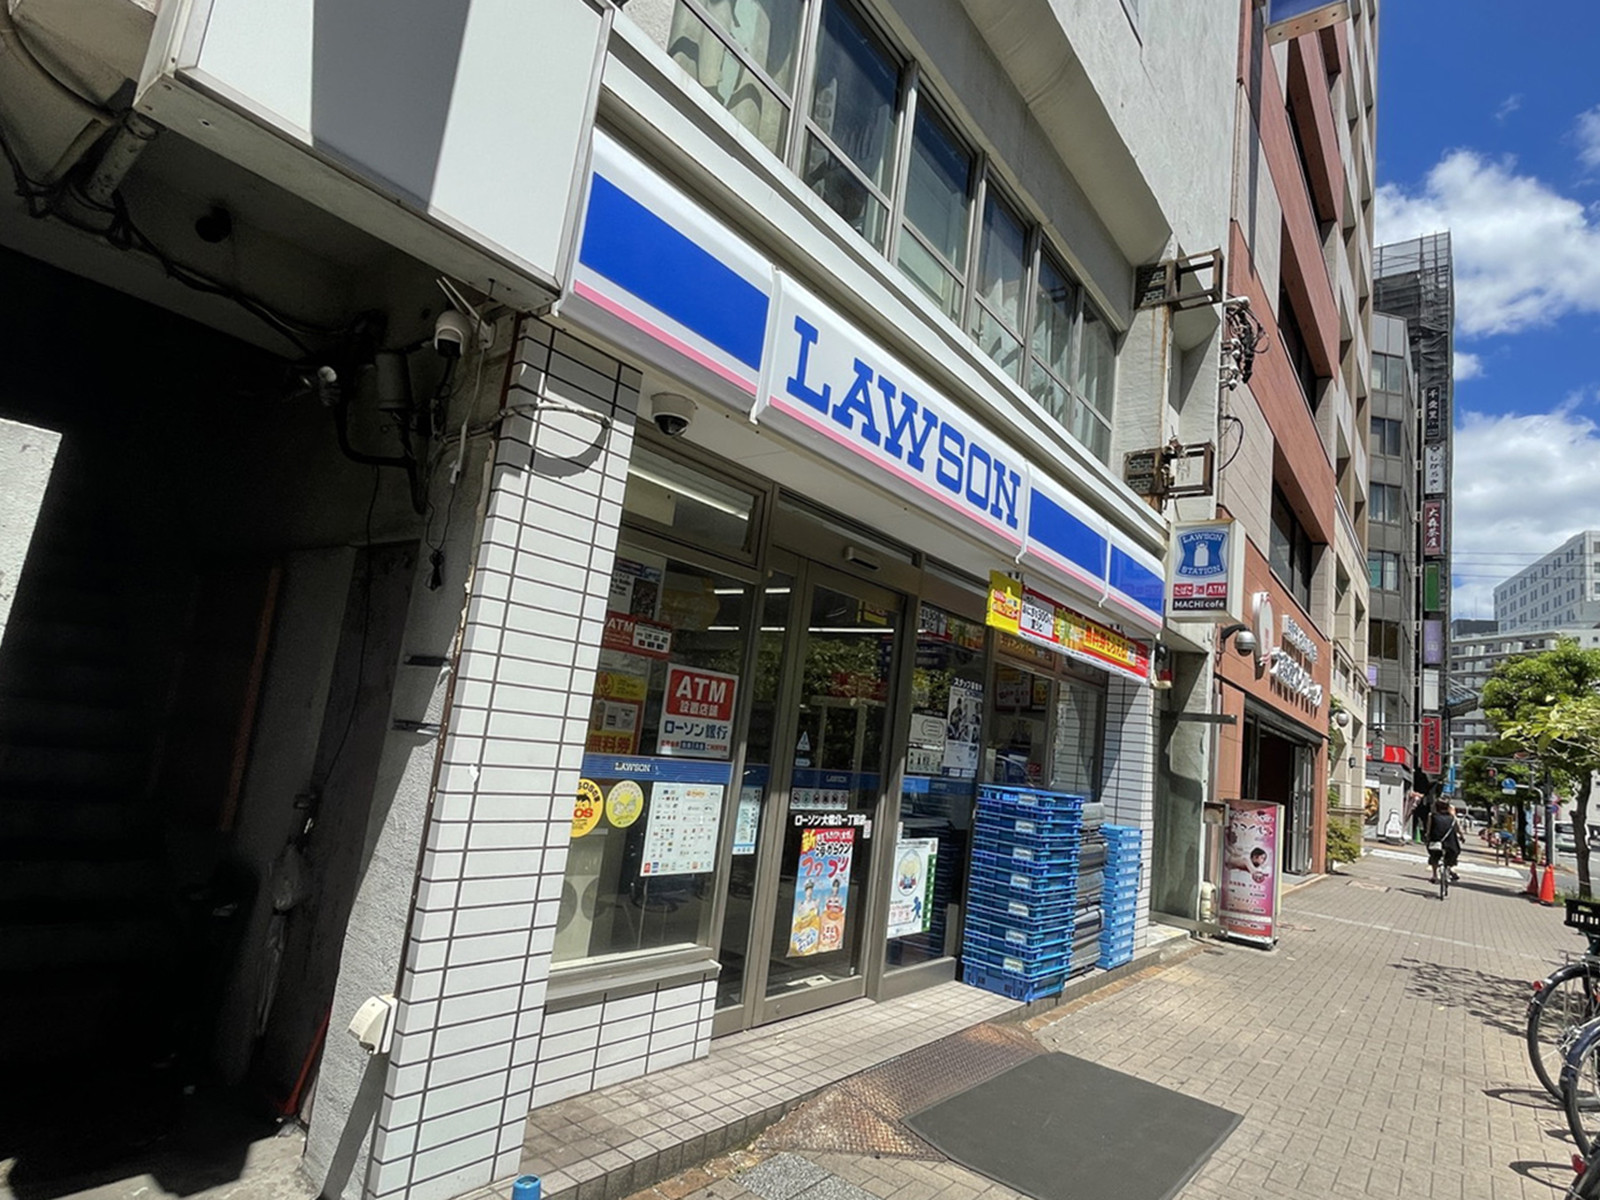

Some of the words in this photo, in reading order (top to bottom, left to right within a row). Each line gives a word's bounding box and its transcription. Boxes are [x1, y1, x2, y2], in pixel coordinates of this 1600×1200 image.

[786, 315, 1021, 530] LAWSON
[1182, 533, 1223, 544] LAWSON
[1181, 564, 1221, 575] STATION
[1206, 585, 1226, 595] ATM
[1174, 600, 1204, 608] MACHI
[607, 617, 634, 632] ATM
[676, 675, 727, 704] ATM
[664, 720, 728, 740] ローソン銀行
[615, 762, 651, 772] LAWSON
[801, 828, 816, 853] 新
